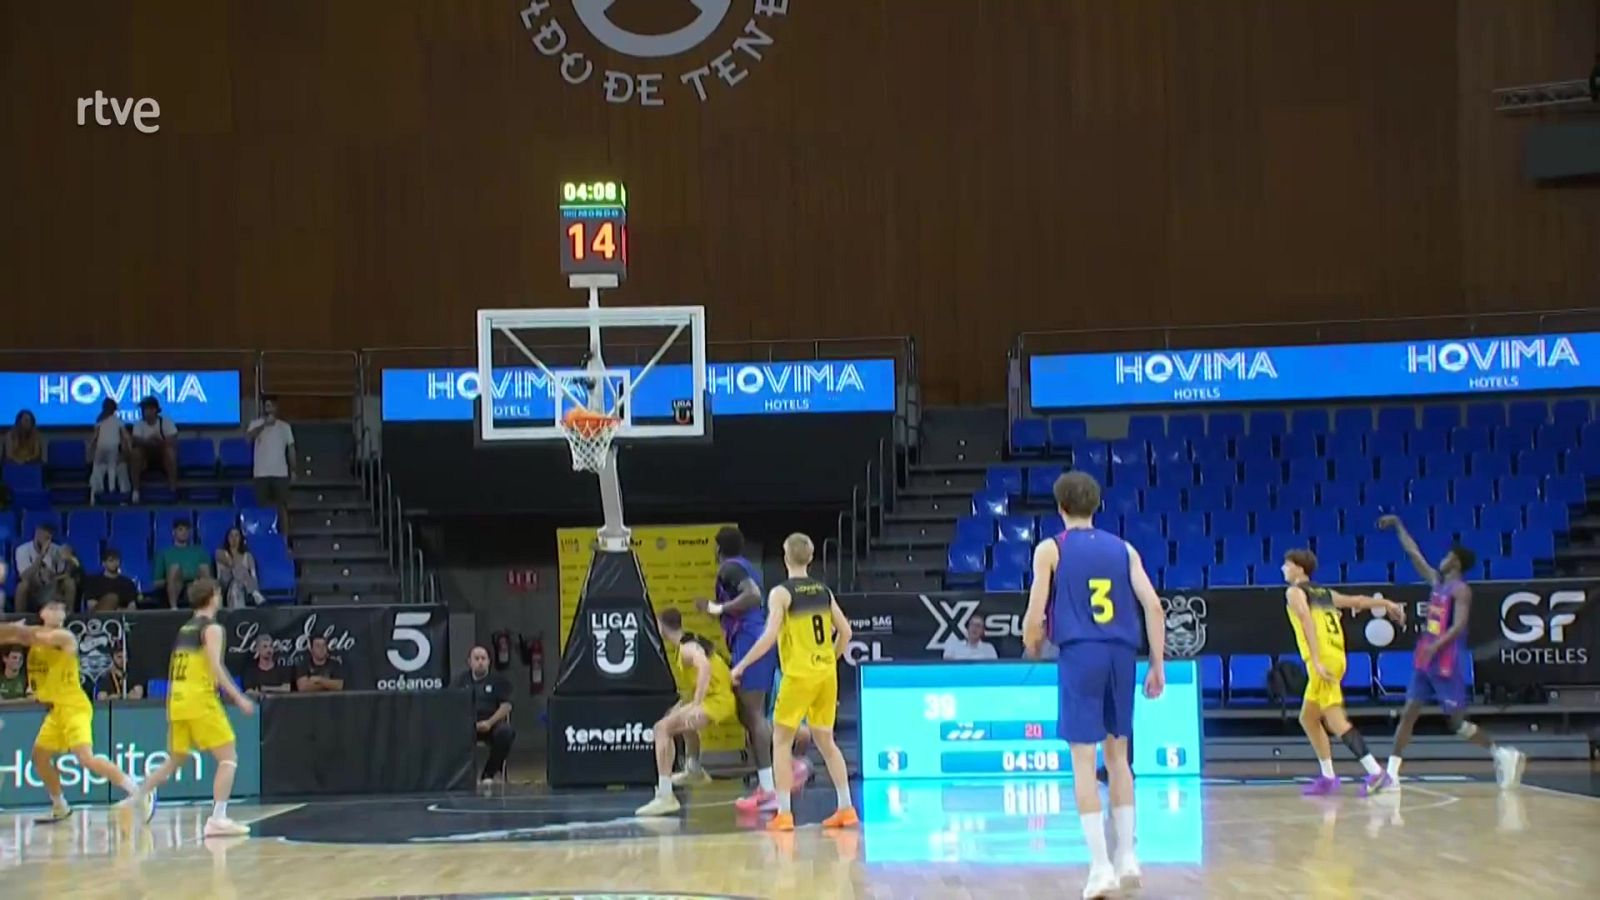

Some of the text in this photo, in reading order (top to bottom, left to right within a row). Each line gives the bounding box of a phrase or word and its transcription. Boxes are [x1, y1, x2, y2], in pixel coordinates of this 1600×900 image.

[603, 70, 664, 105] DE
[564, 182, 617, 201] 04:08
[568, 222, 616, 259] 14
[1408, 338, 1580, 373] HOVIMA
[709, 363, 866, 395] HOVIMA
[1114, 352, 1278, 384] HOVIMA
[39, 374, 208, 404] HOVIMA
[1469, 375, 1519, 389] HOTELS
[764, 399, 810, 411] HOTELS
[1174, 388, 1221, 400] HOTELS
[494, 405, 531, 417] OTELS
[1088, 578, 1115, 624] 3
[591, 612, 638, 629] LIGA
[849, 619, 871, 629] rupo
[1500, 591, 1587, 643] GF
[812, 614, 825, 645] 8
[386, 611, 432, 672] 5
[1501, 648, 1588, 665] HOTELES
[377, 675, 443, 691] océanos
[564, 722, 656, 744] tenerife
[1002, 751, 1059, 771] 04:08
